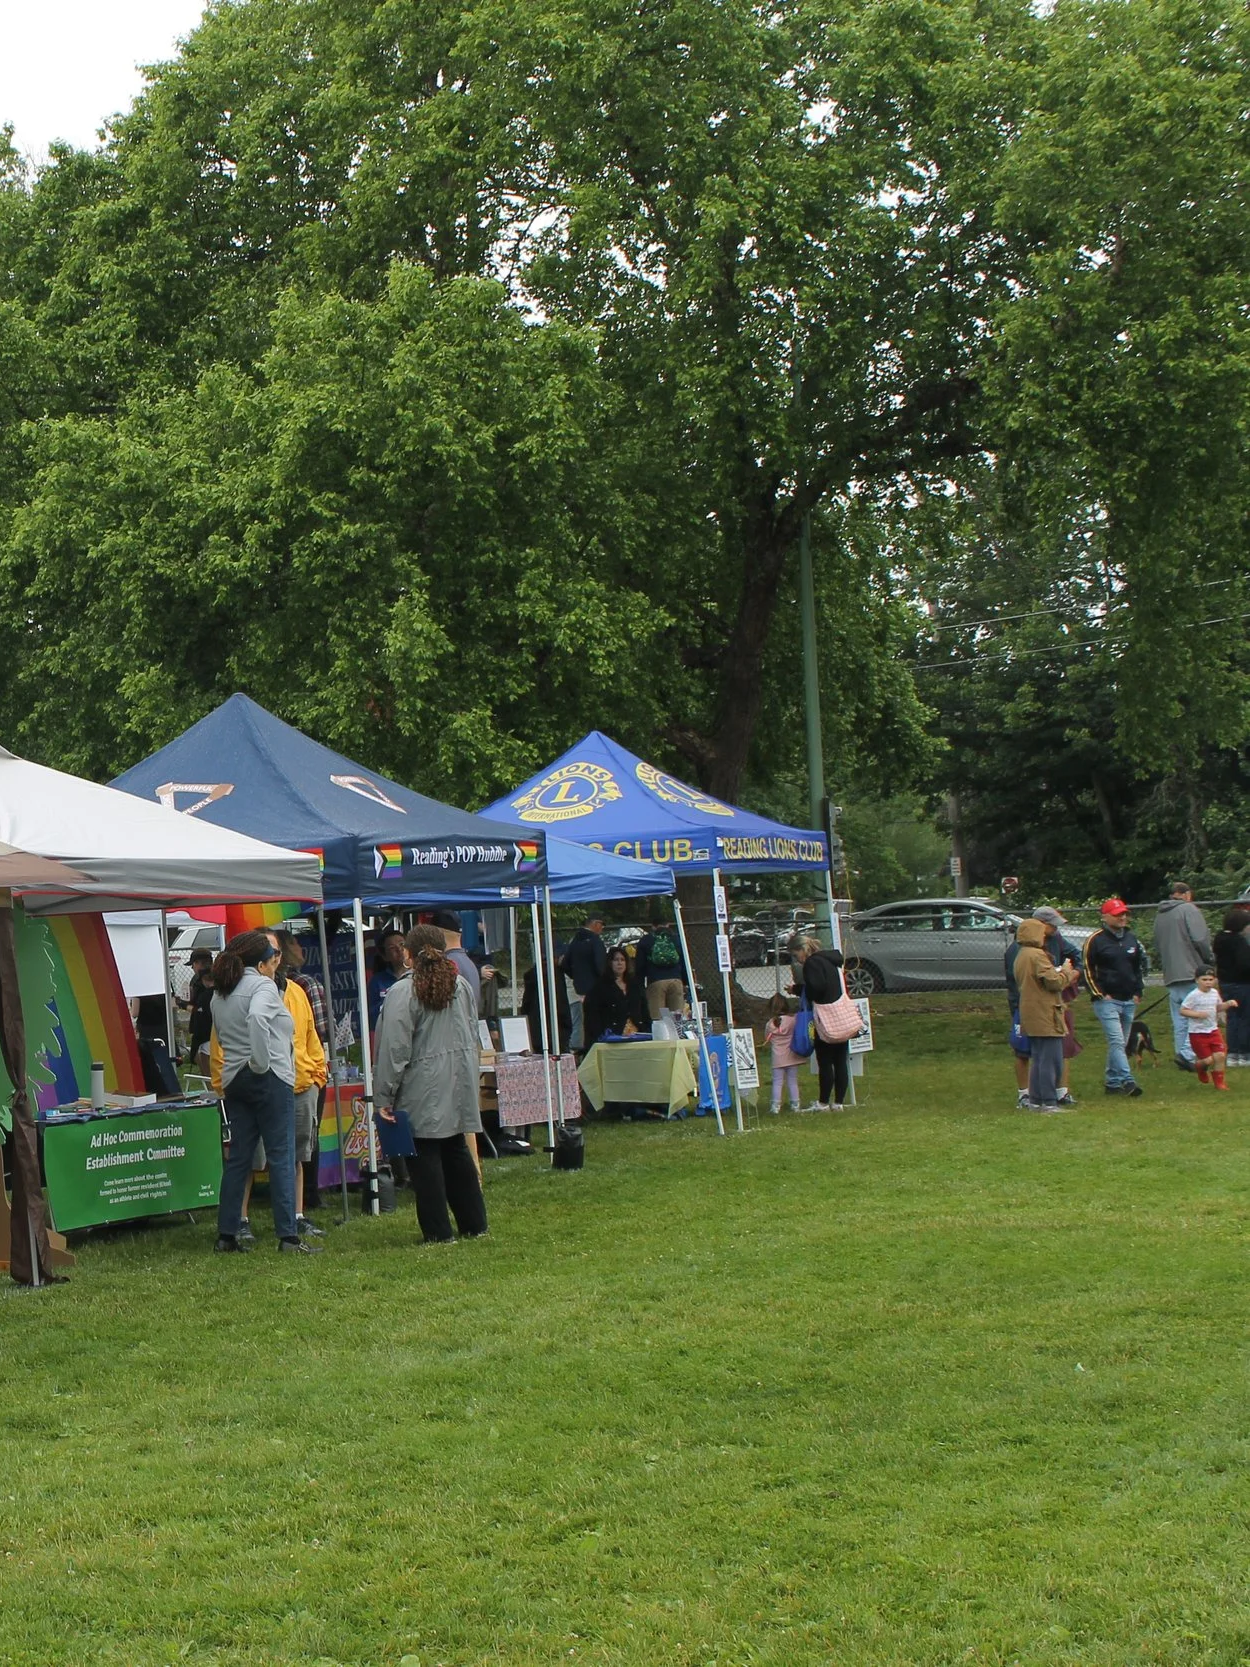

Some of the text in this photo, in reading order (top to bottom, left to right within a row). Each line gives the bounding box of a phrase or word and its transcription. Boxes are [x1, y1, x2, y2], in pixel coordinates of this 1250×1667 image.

[550, 781, 580, 803] L
[410, 845, 507, 868] Reading's POP Huddle
[613, 839, 693, 862] CLUB
[722, 837, 769, 860] READING
[769, 837, 797, 860] LIONS
[798, 840, 823, 861] CLUB
[90, 1124, 183, 1148] Ad Hoc Commemoration
[86, 1149, 144, 1170] Establishment
